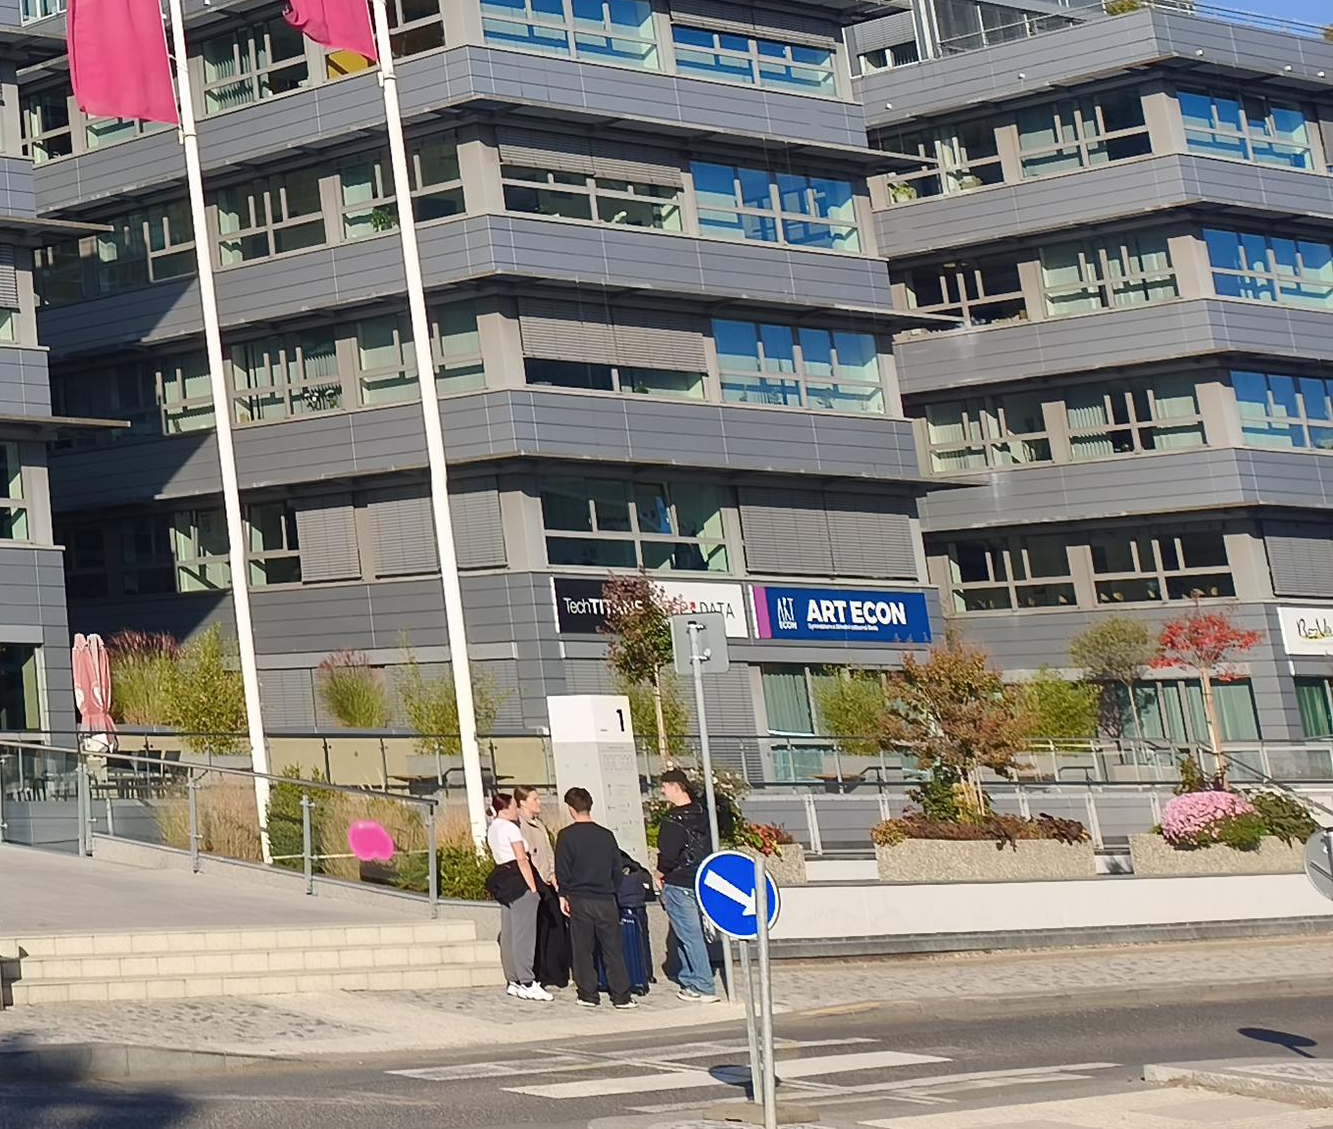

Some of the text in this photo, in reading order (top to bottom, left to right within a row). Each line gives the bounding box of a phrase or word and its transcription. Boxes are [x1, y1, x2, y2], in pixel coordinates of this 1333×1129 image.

[807, 599, 847, 623] ART
[849, 600, 907, 625] ECON
[616, 708, 625, 732] 1
